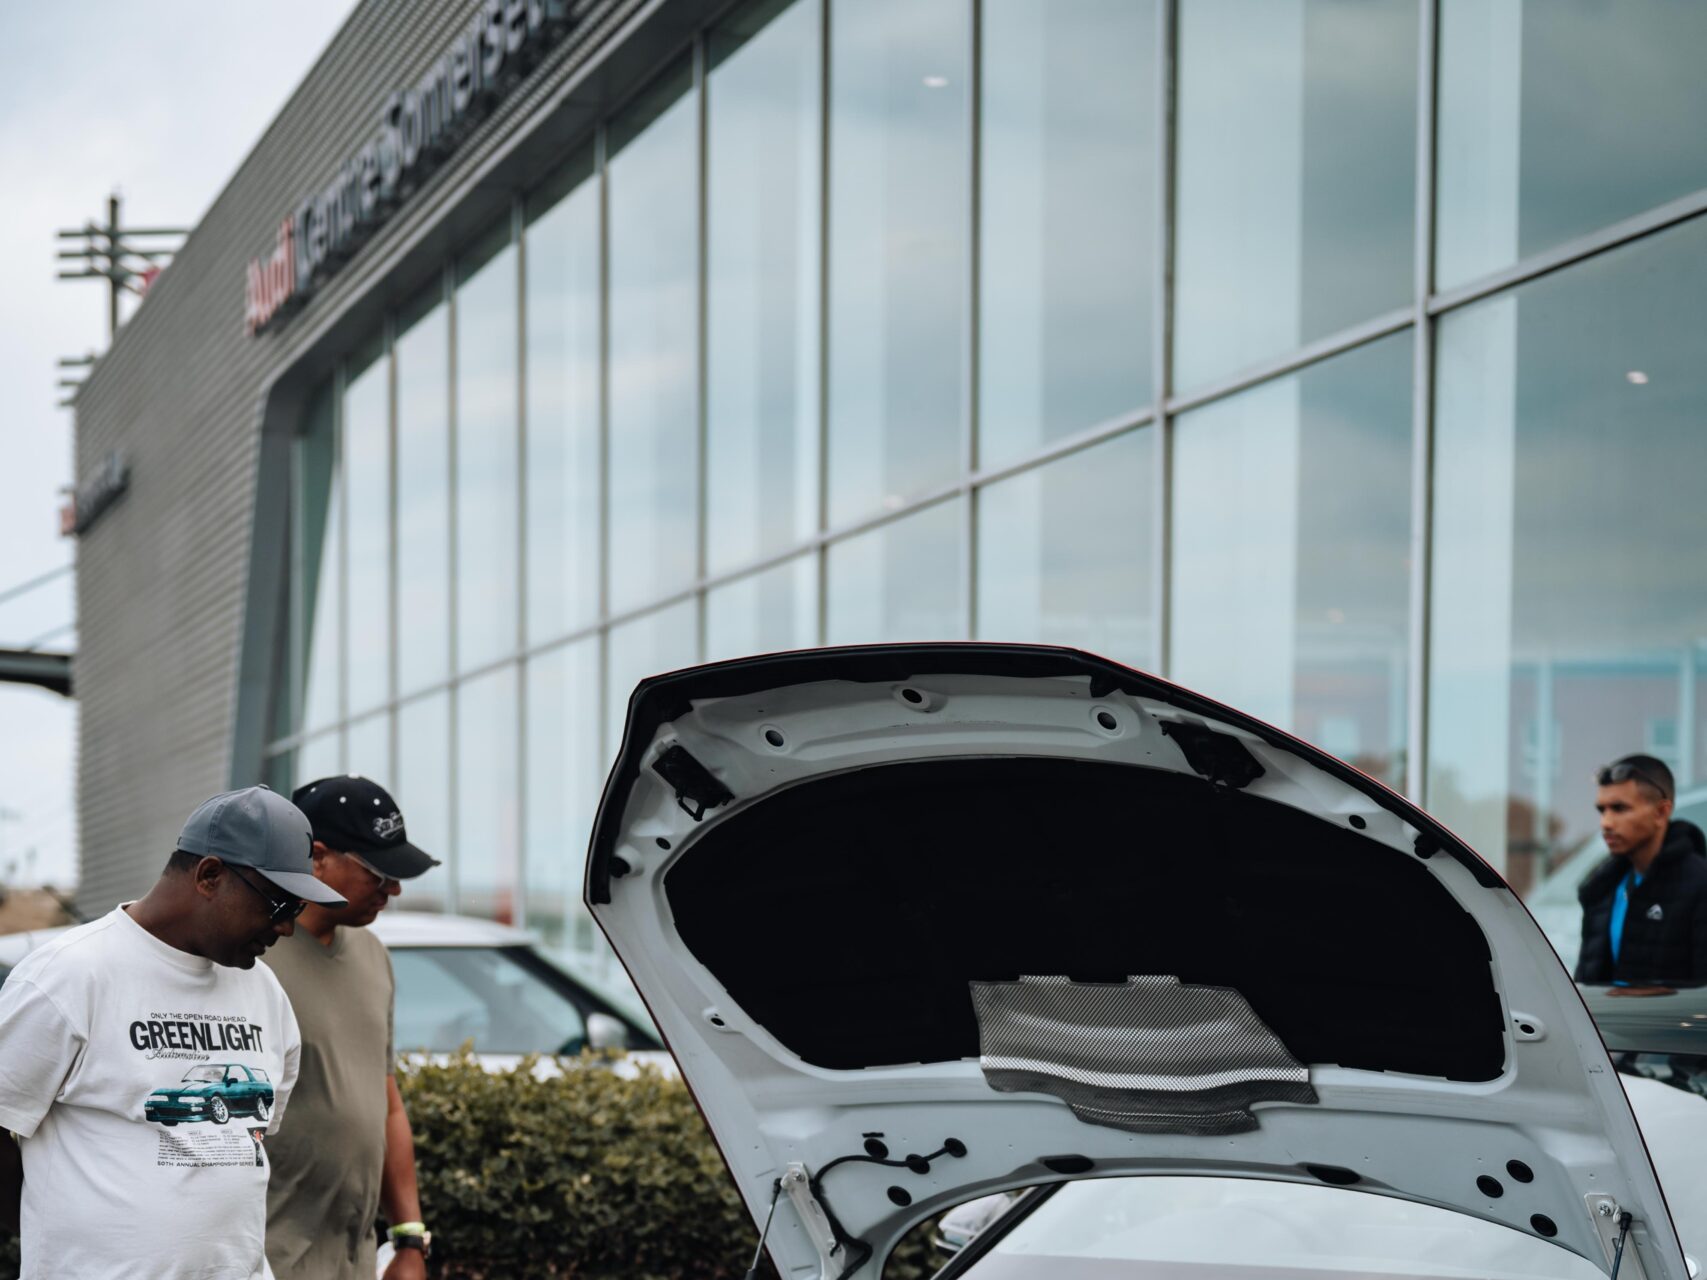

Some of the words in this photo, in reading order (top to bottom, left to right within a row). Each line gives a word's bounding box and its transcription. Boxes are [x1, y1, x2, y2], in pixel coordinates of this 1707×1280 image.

[245, 214, 295, 337] Audi
[150, 1012, 168, 1020] ONLY
[169, 1012, 183, 1020] THE
[183, 1013, 203, 1021] OPEN
[204, 1014, 222, 1022] ROAD
[129, 1020, 263, 1053] GREENLIGHT
